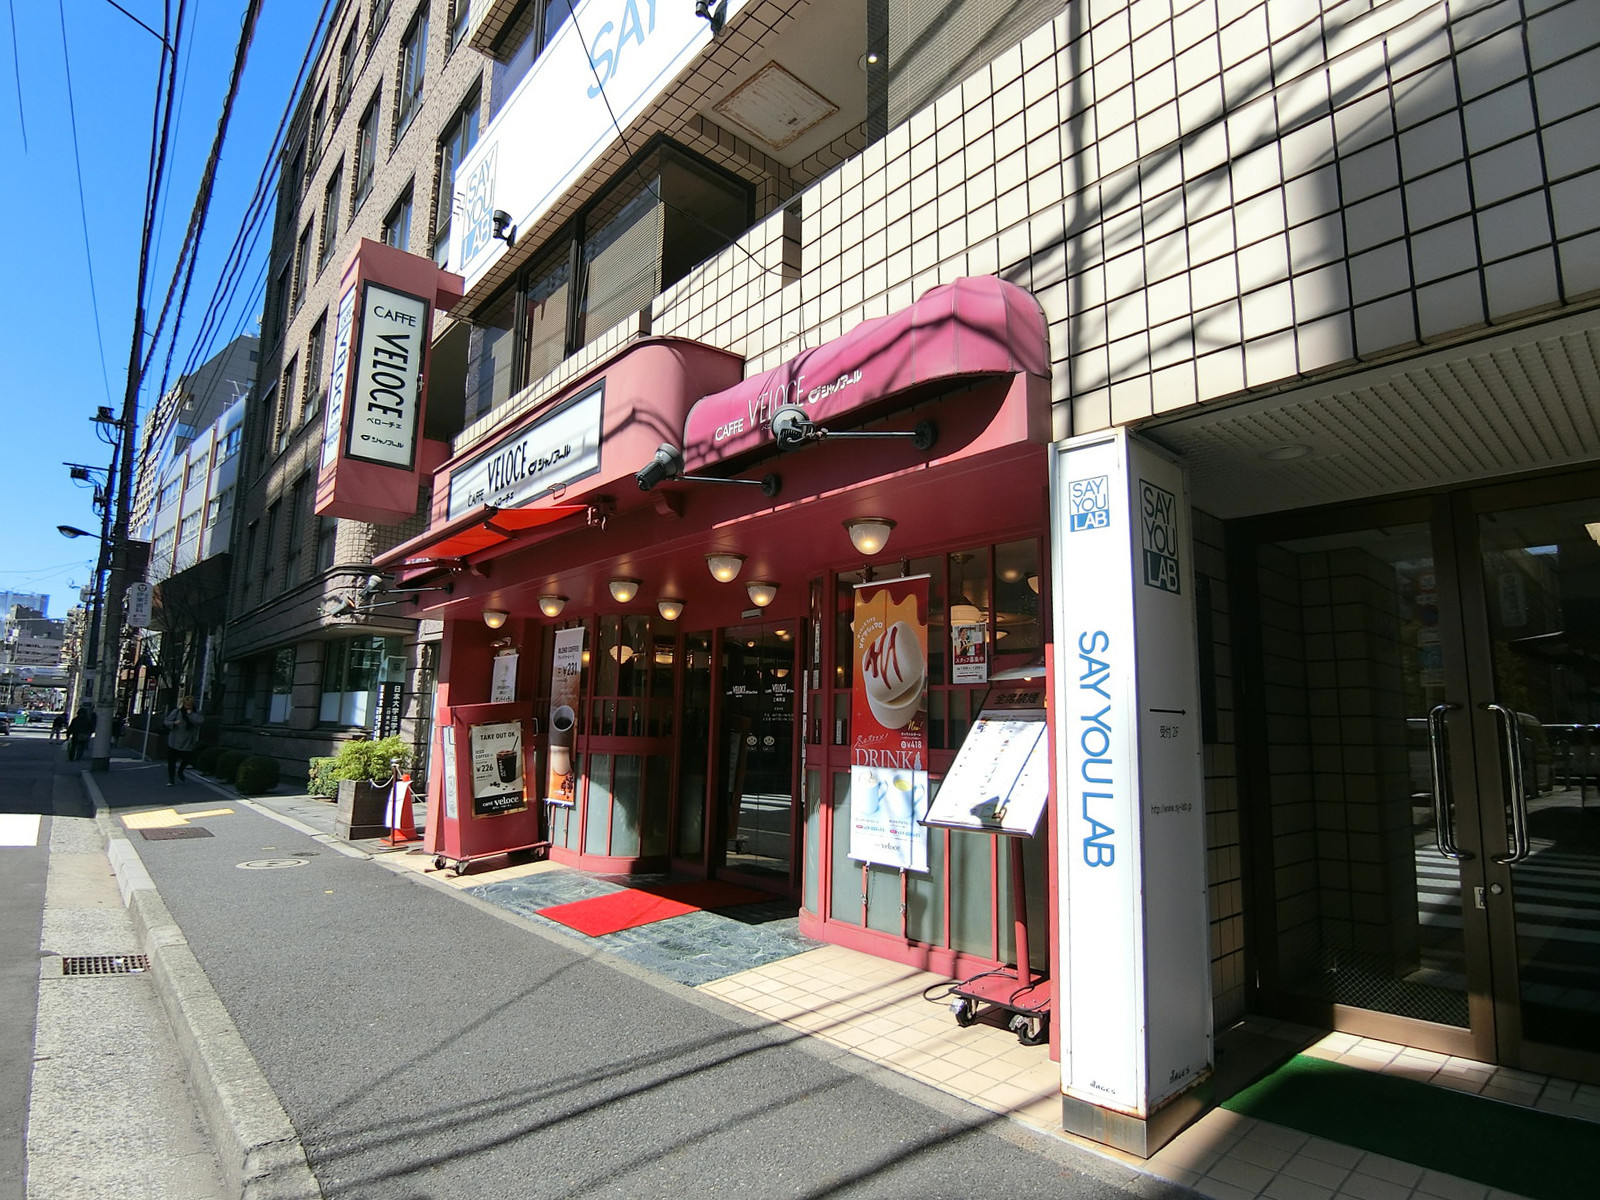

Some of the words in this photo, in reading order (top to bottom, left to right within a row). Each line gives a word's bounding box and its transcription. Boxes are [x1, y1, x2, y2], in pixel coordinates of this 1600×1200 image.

[468, 149, 495, 204] SAY
[467, 178, 493, 232] YOU
[465, 218, 490, 261] LAB
[373, 305, 416, 327] CAFFE
[367, 334, 410, 419] VELOCE
[748, 375, 806, 428] VELOCE
[366, 417, 402, 429] ベローチェ
[715, 418, 744, 441] CAFFE
[488, 441, 528, 494] VELOCE
[467, 489, 485, 507] CAFFE
[1072, 478, 1104, 498] SAY
[1072, 494, 1106, 513] YOU
[1144, 486, 1172, 526] SAY
[1074, 512, 1107, 531] LAB
[1144, 516, 1176, 557] YOU
[1147, 552, 1178, 592] LAB
[955, 656, 984, 664] スタッフ募集中
[994, 692, 1040, 704] 全席禁煙
[476, 764, 494, 772] ¥226
[855, 748, 913, 770] DRINK
[494, 796, 519, 806] veloce
